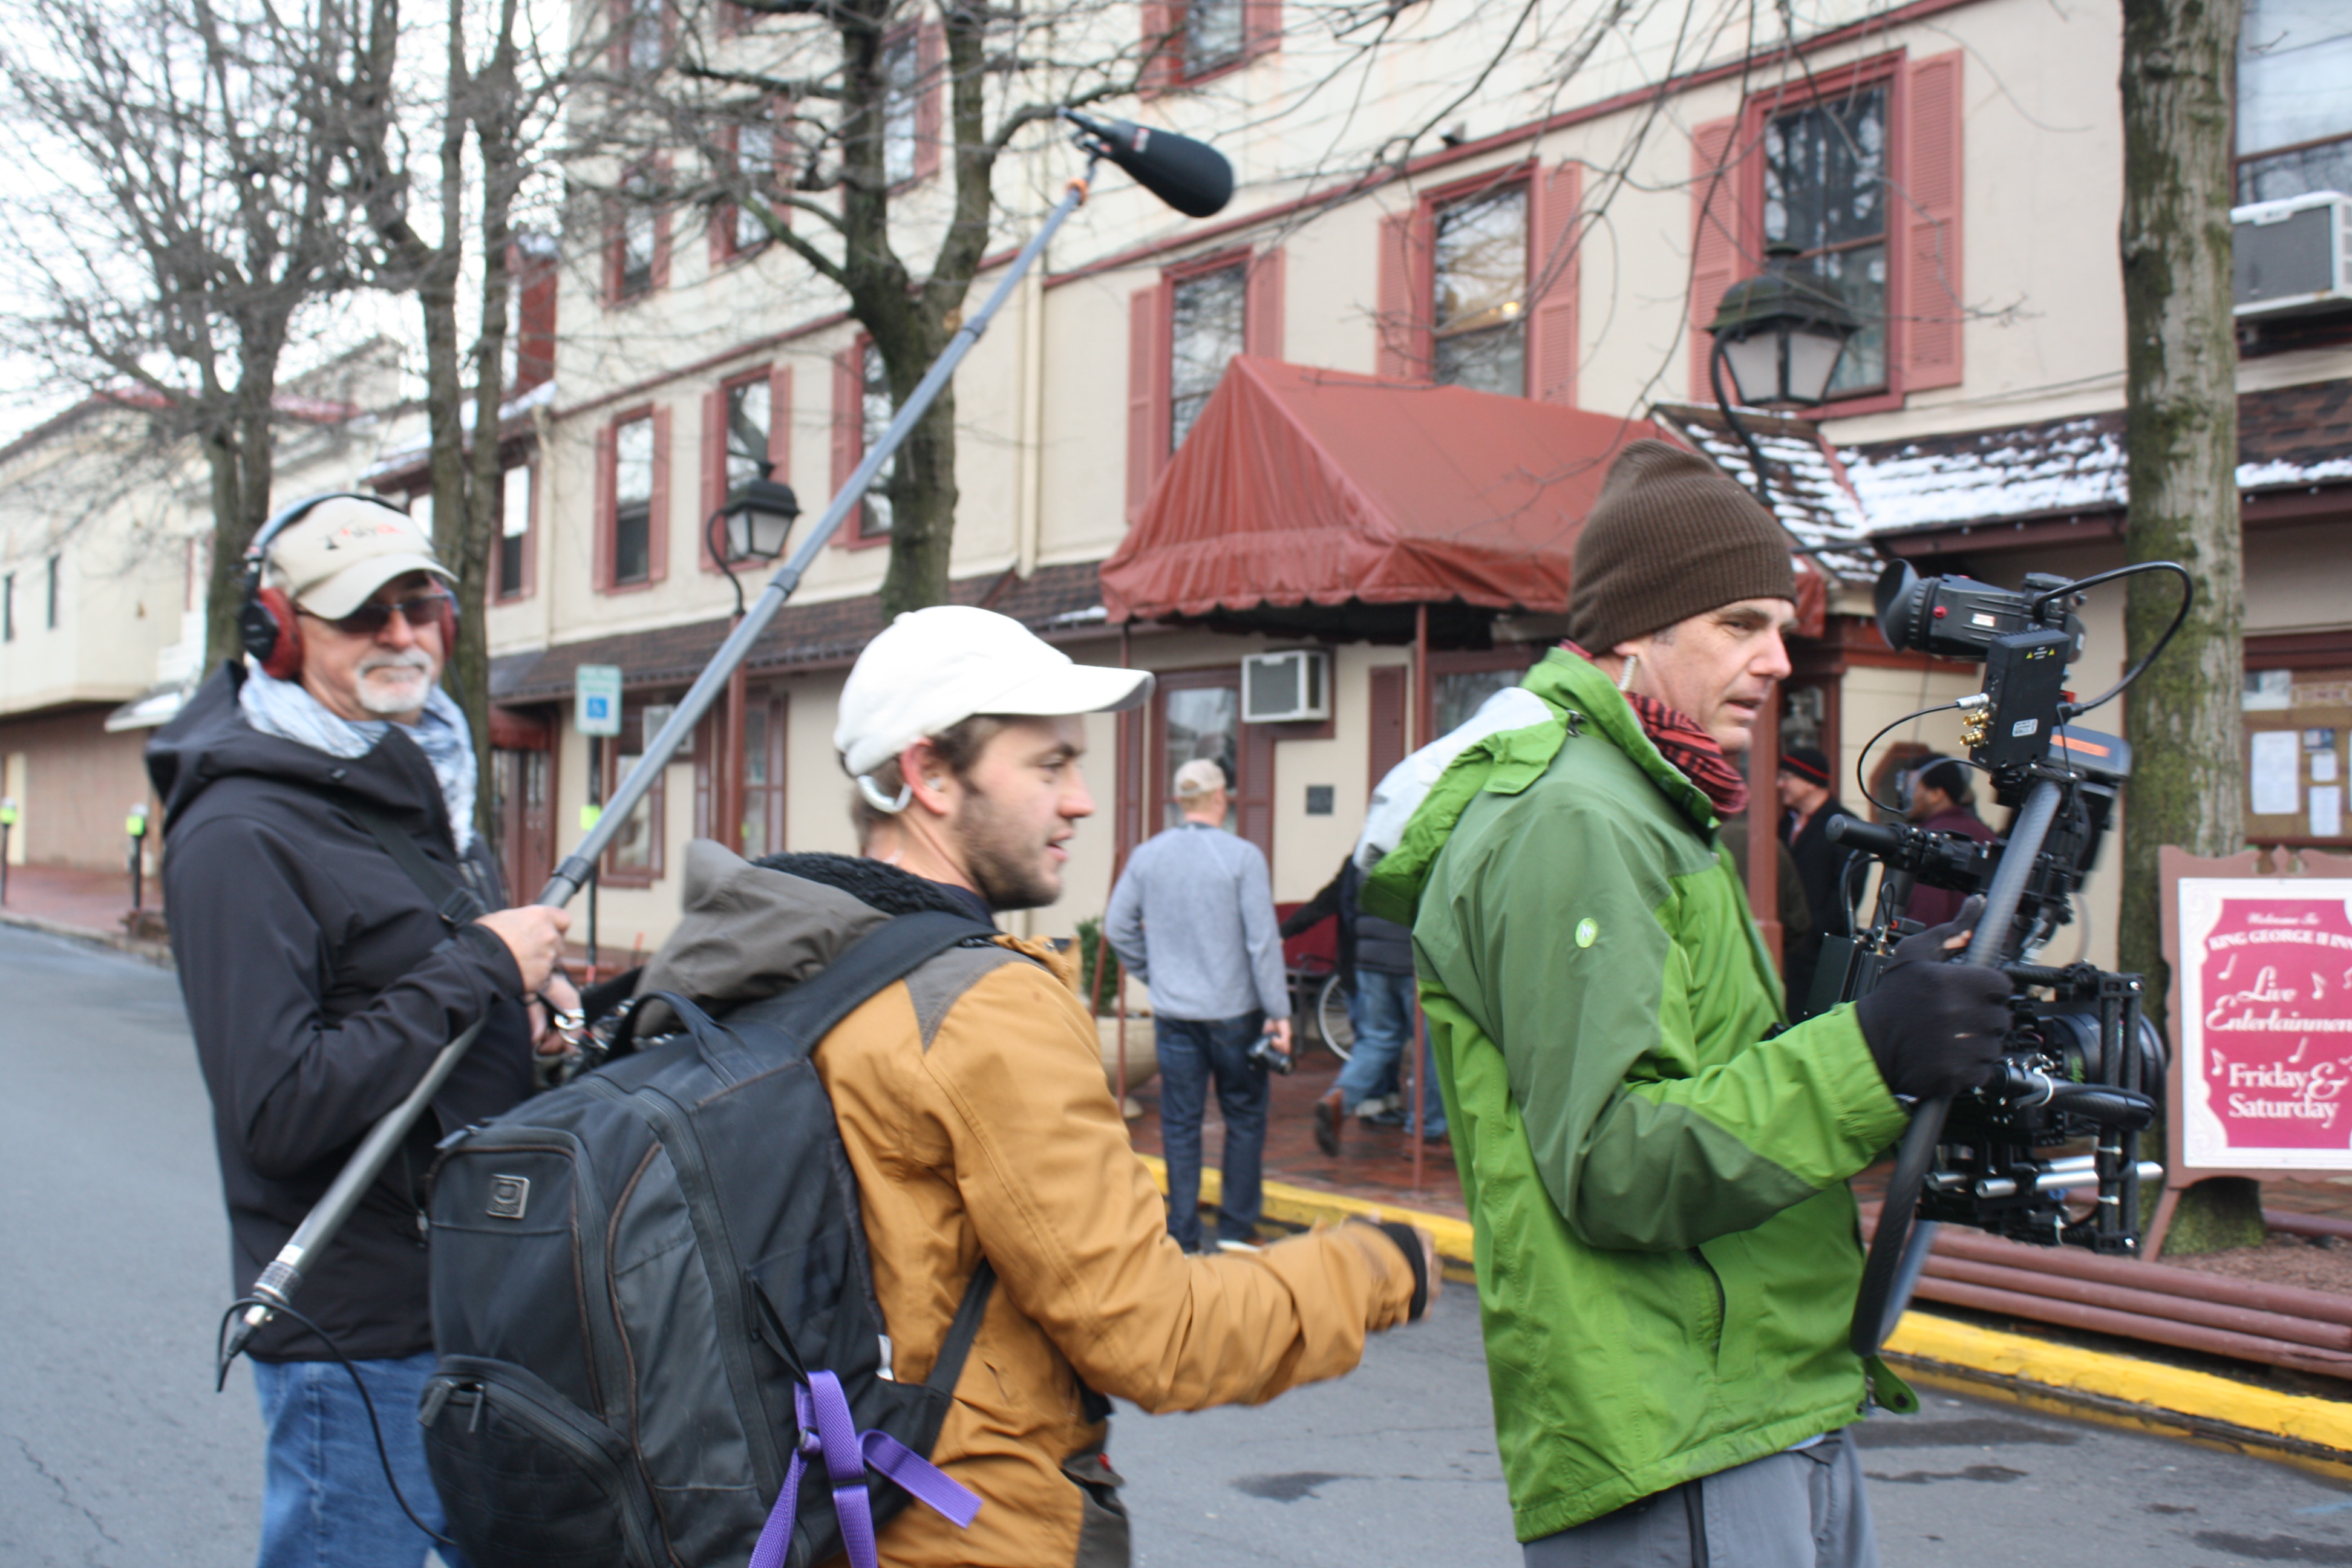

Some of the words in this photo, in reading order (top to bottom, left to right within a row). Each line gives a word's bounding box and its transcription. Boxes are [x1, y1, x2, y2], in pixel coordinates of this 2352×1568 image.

[2208, 931, 2248, 950] KING
[2249, 929, 2314, 944] GEORGE
[2316, 932, 2329, 946] II
[2236, 965, 2297, 1002] Live
[2205, 995, 2352, 1032] Entertainmen
[2229, 1062, 2310, 1098] Friday
[2228, 1093, 2339, 1129] Saturday
